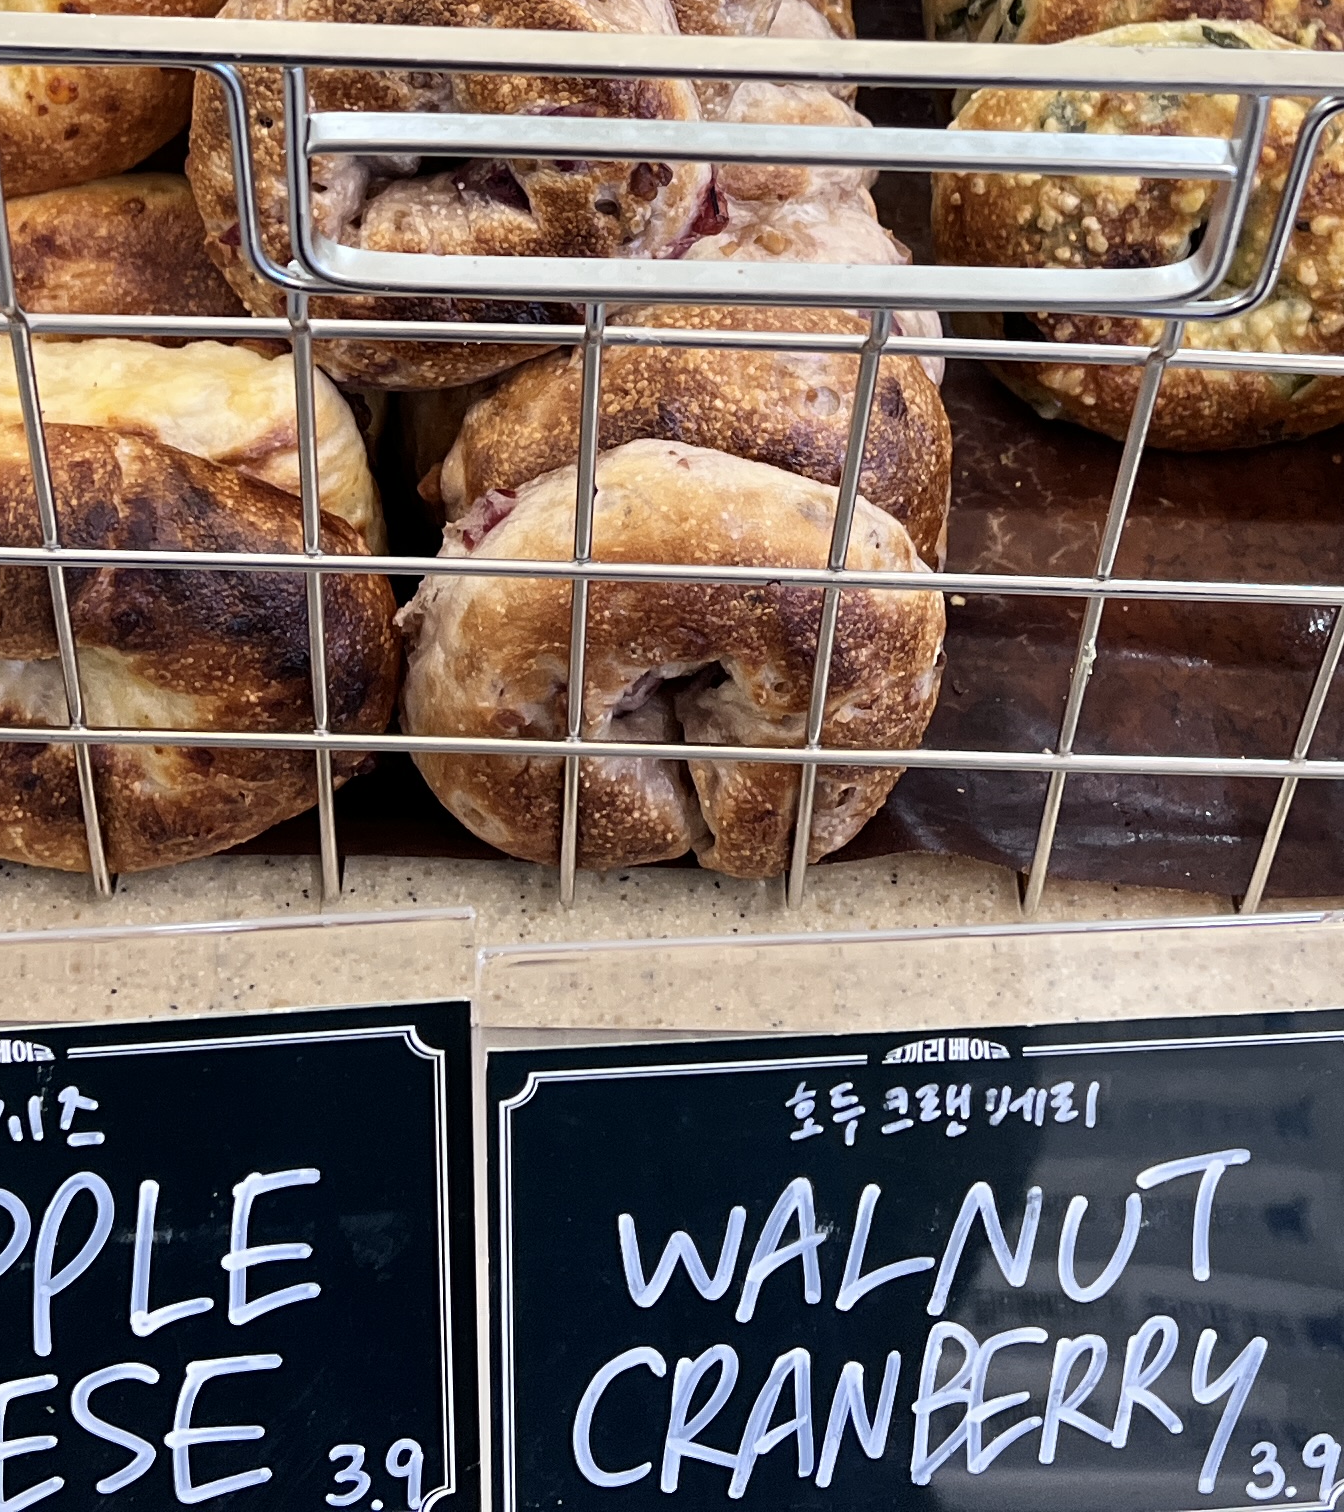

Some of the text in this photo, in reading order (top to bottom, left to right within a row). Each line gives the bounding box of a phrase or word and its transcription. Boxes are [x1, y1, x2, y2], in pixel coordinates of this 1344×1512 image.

[785, 1081, 866, 1147] 호두
[618, 1148, 1251, 1324] WALNUT
[572, 1314, 1269, 1499] CRANBERRY
[325, 1437, 425, 1512] 3.9
[1245, 1432, 1342, 1503] 3.9
